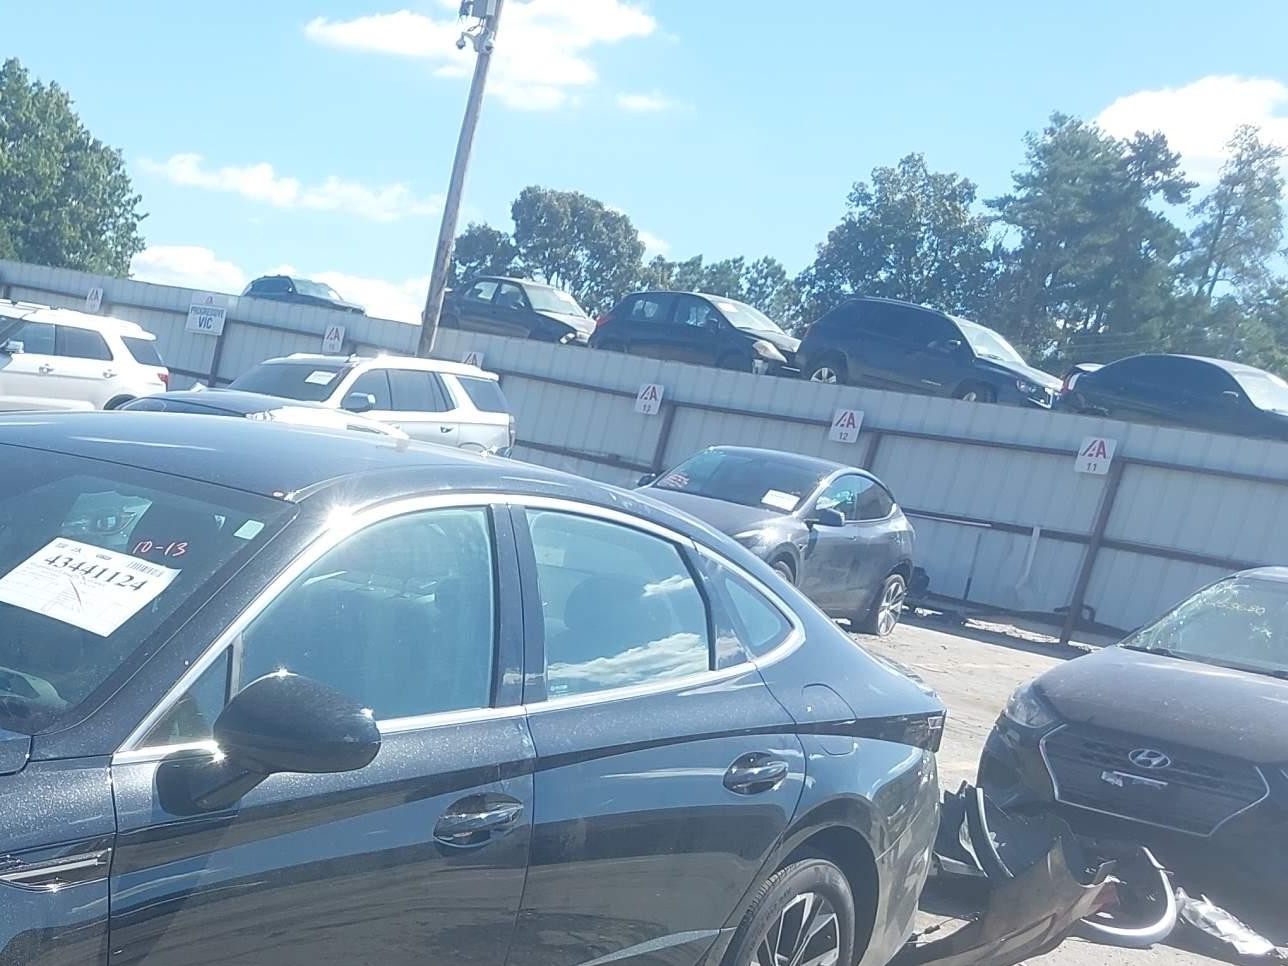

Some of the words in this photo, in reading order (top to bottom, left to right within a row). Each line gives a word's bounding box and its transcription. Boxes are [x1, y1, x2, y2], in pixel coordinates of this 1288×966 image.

[198, 316, 213, 329] VIC
[839, 431, 849, 441] 12
[1087, 462, 1098, 472] 11
[132, 540, 189, 558] 10-13
[45, 554, 148, 592] 43441124
